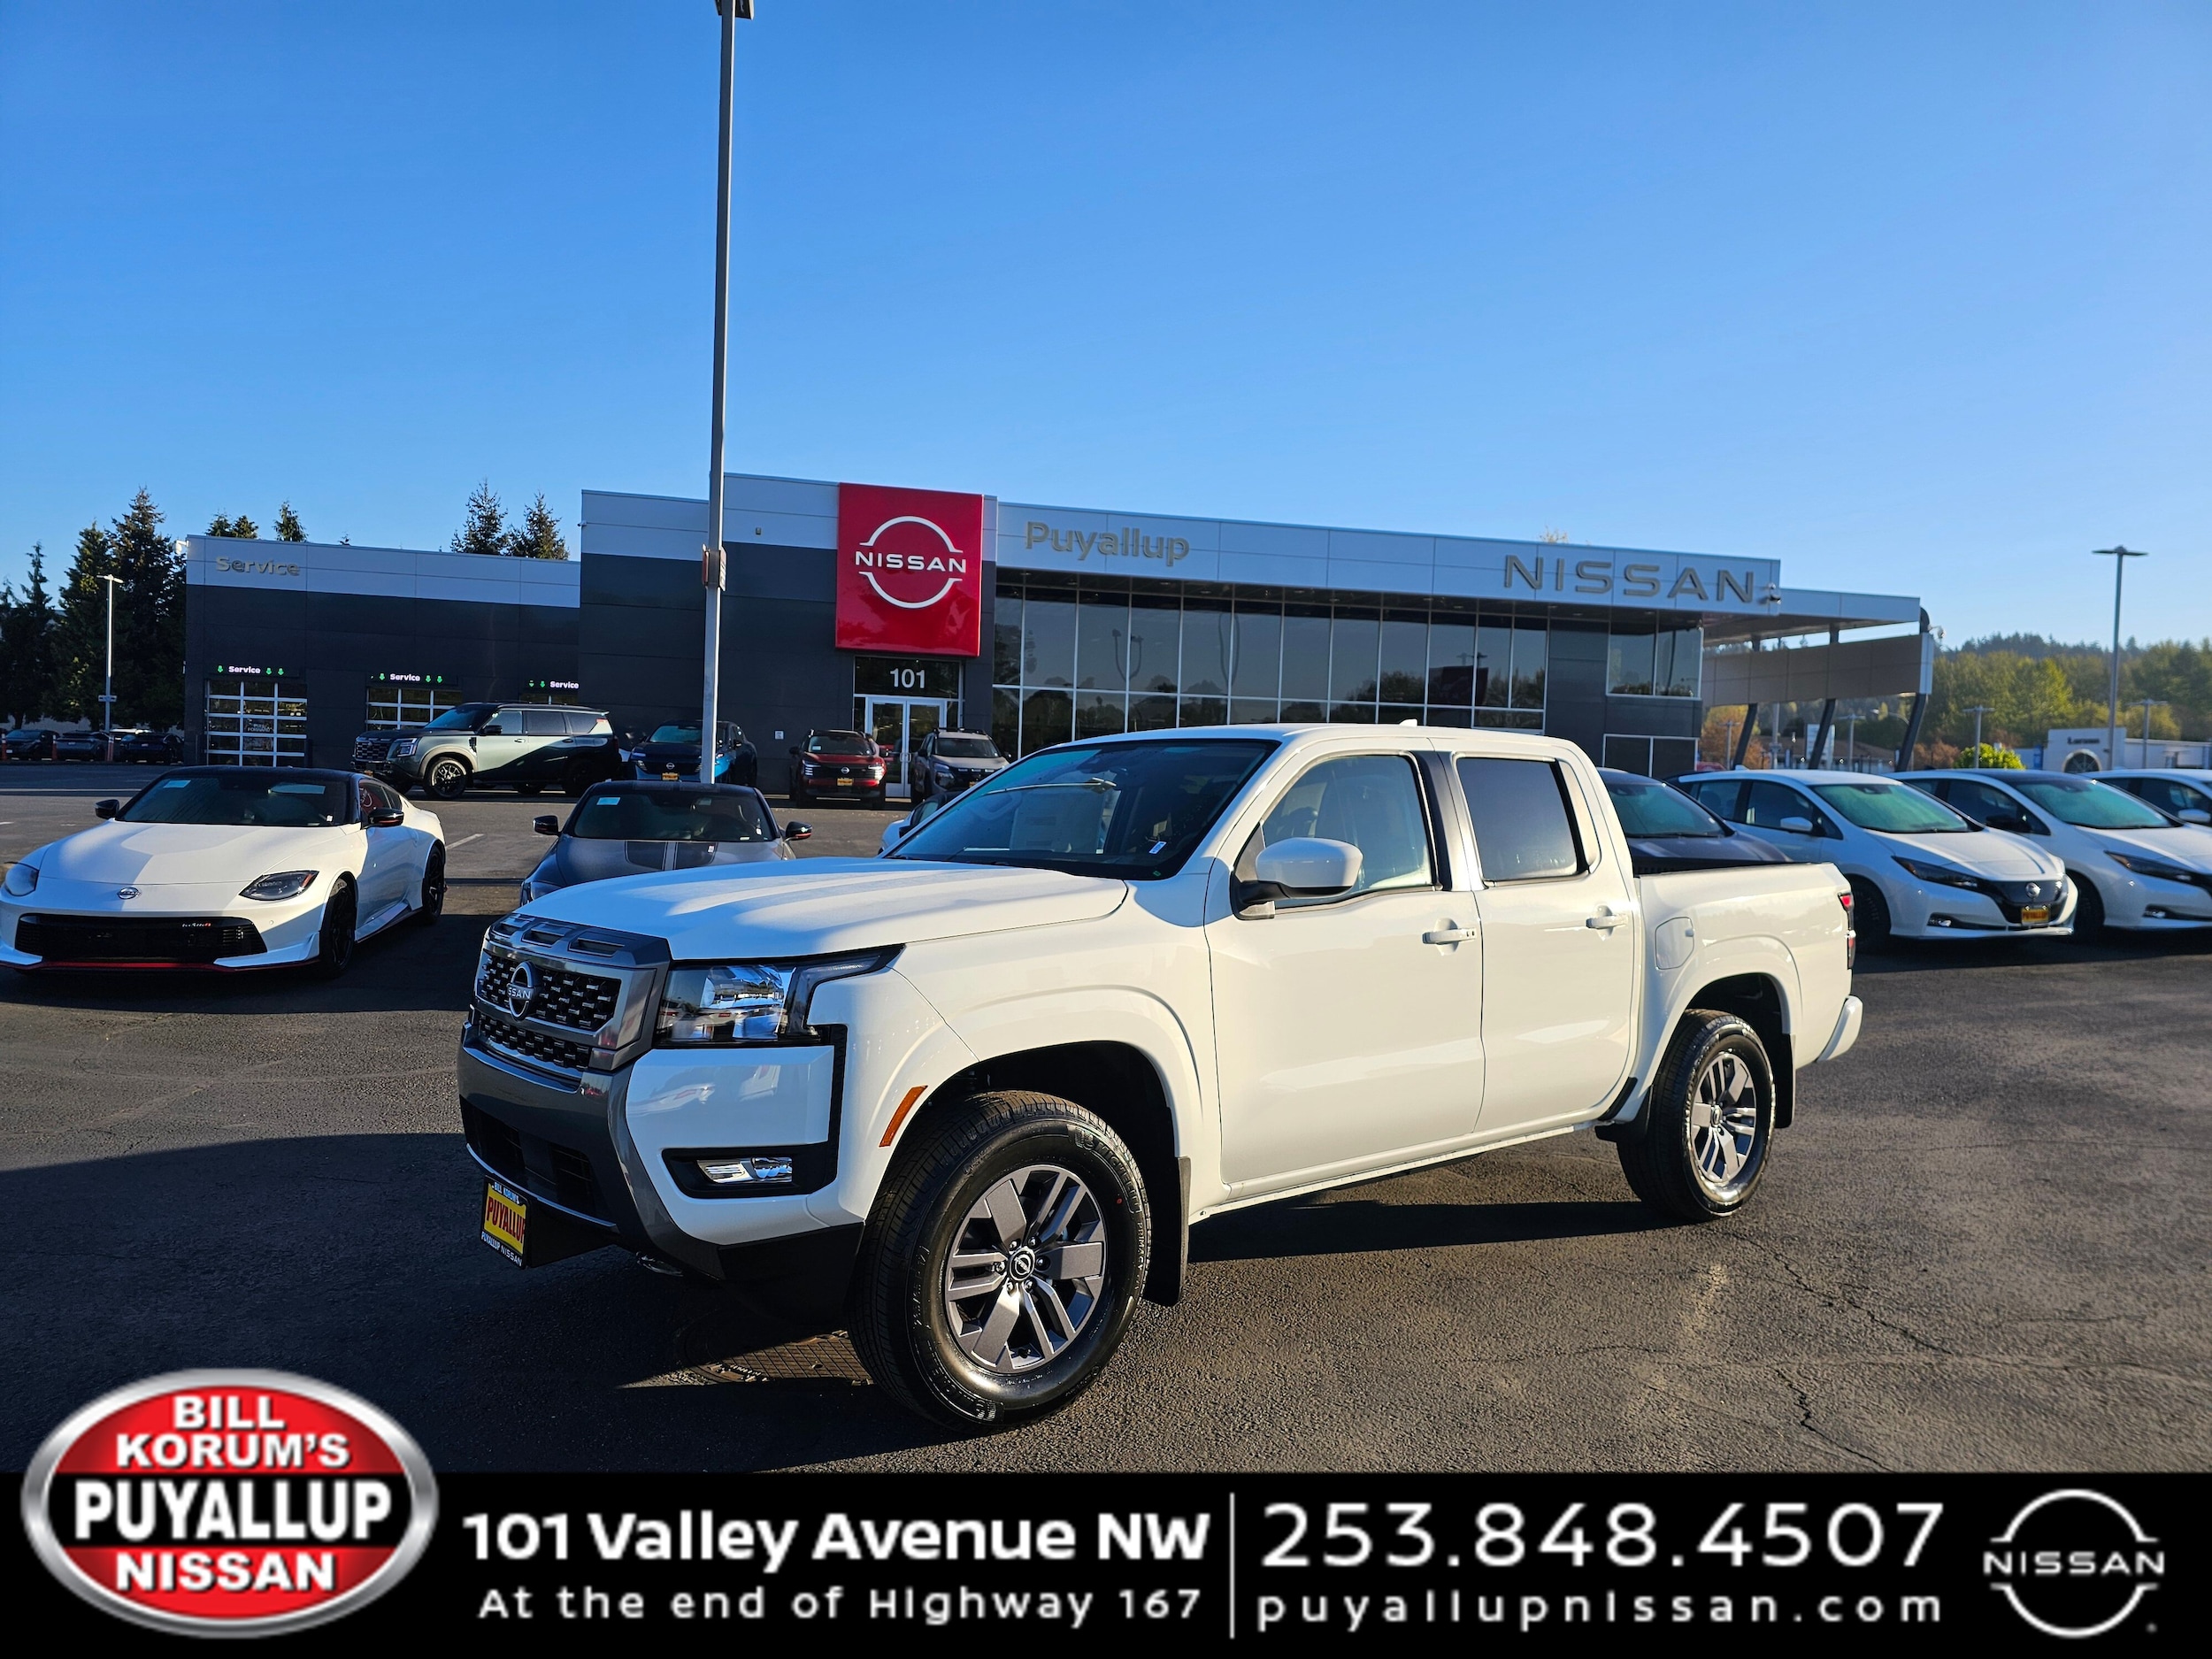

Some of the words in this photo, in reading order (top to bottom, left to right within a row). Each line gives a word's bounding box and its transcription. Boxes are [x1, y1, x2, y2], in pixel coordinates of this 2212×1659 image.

[1025, 520, 1190, 567] Puyallup
[215, 555, 301, 577] Service
[854, 549, 967, 574] NISSAN
[1503, 554, 1755, 603] NISSAN
[228, 665, 261, 674] Service
[389, 673, 421, 682] Service
[890, 668, 925, 688] 101
[549, 680, 580, 689] Service
[507, 987, 532, 1000] SSAN
[501, 1244, 523, 1267] NISSAN
